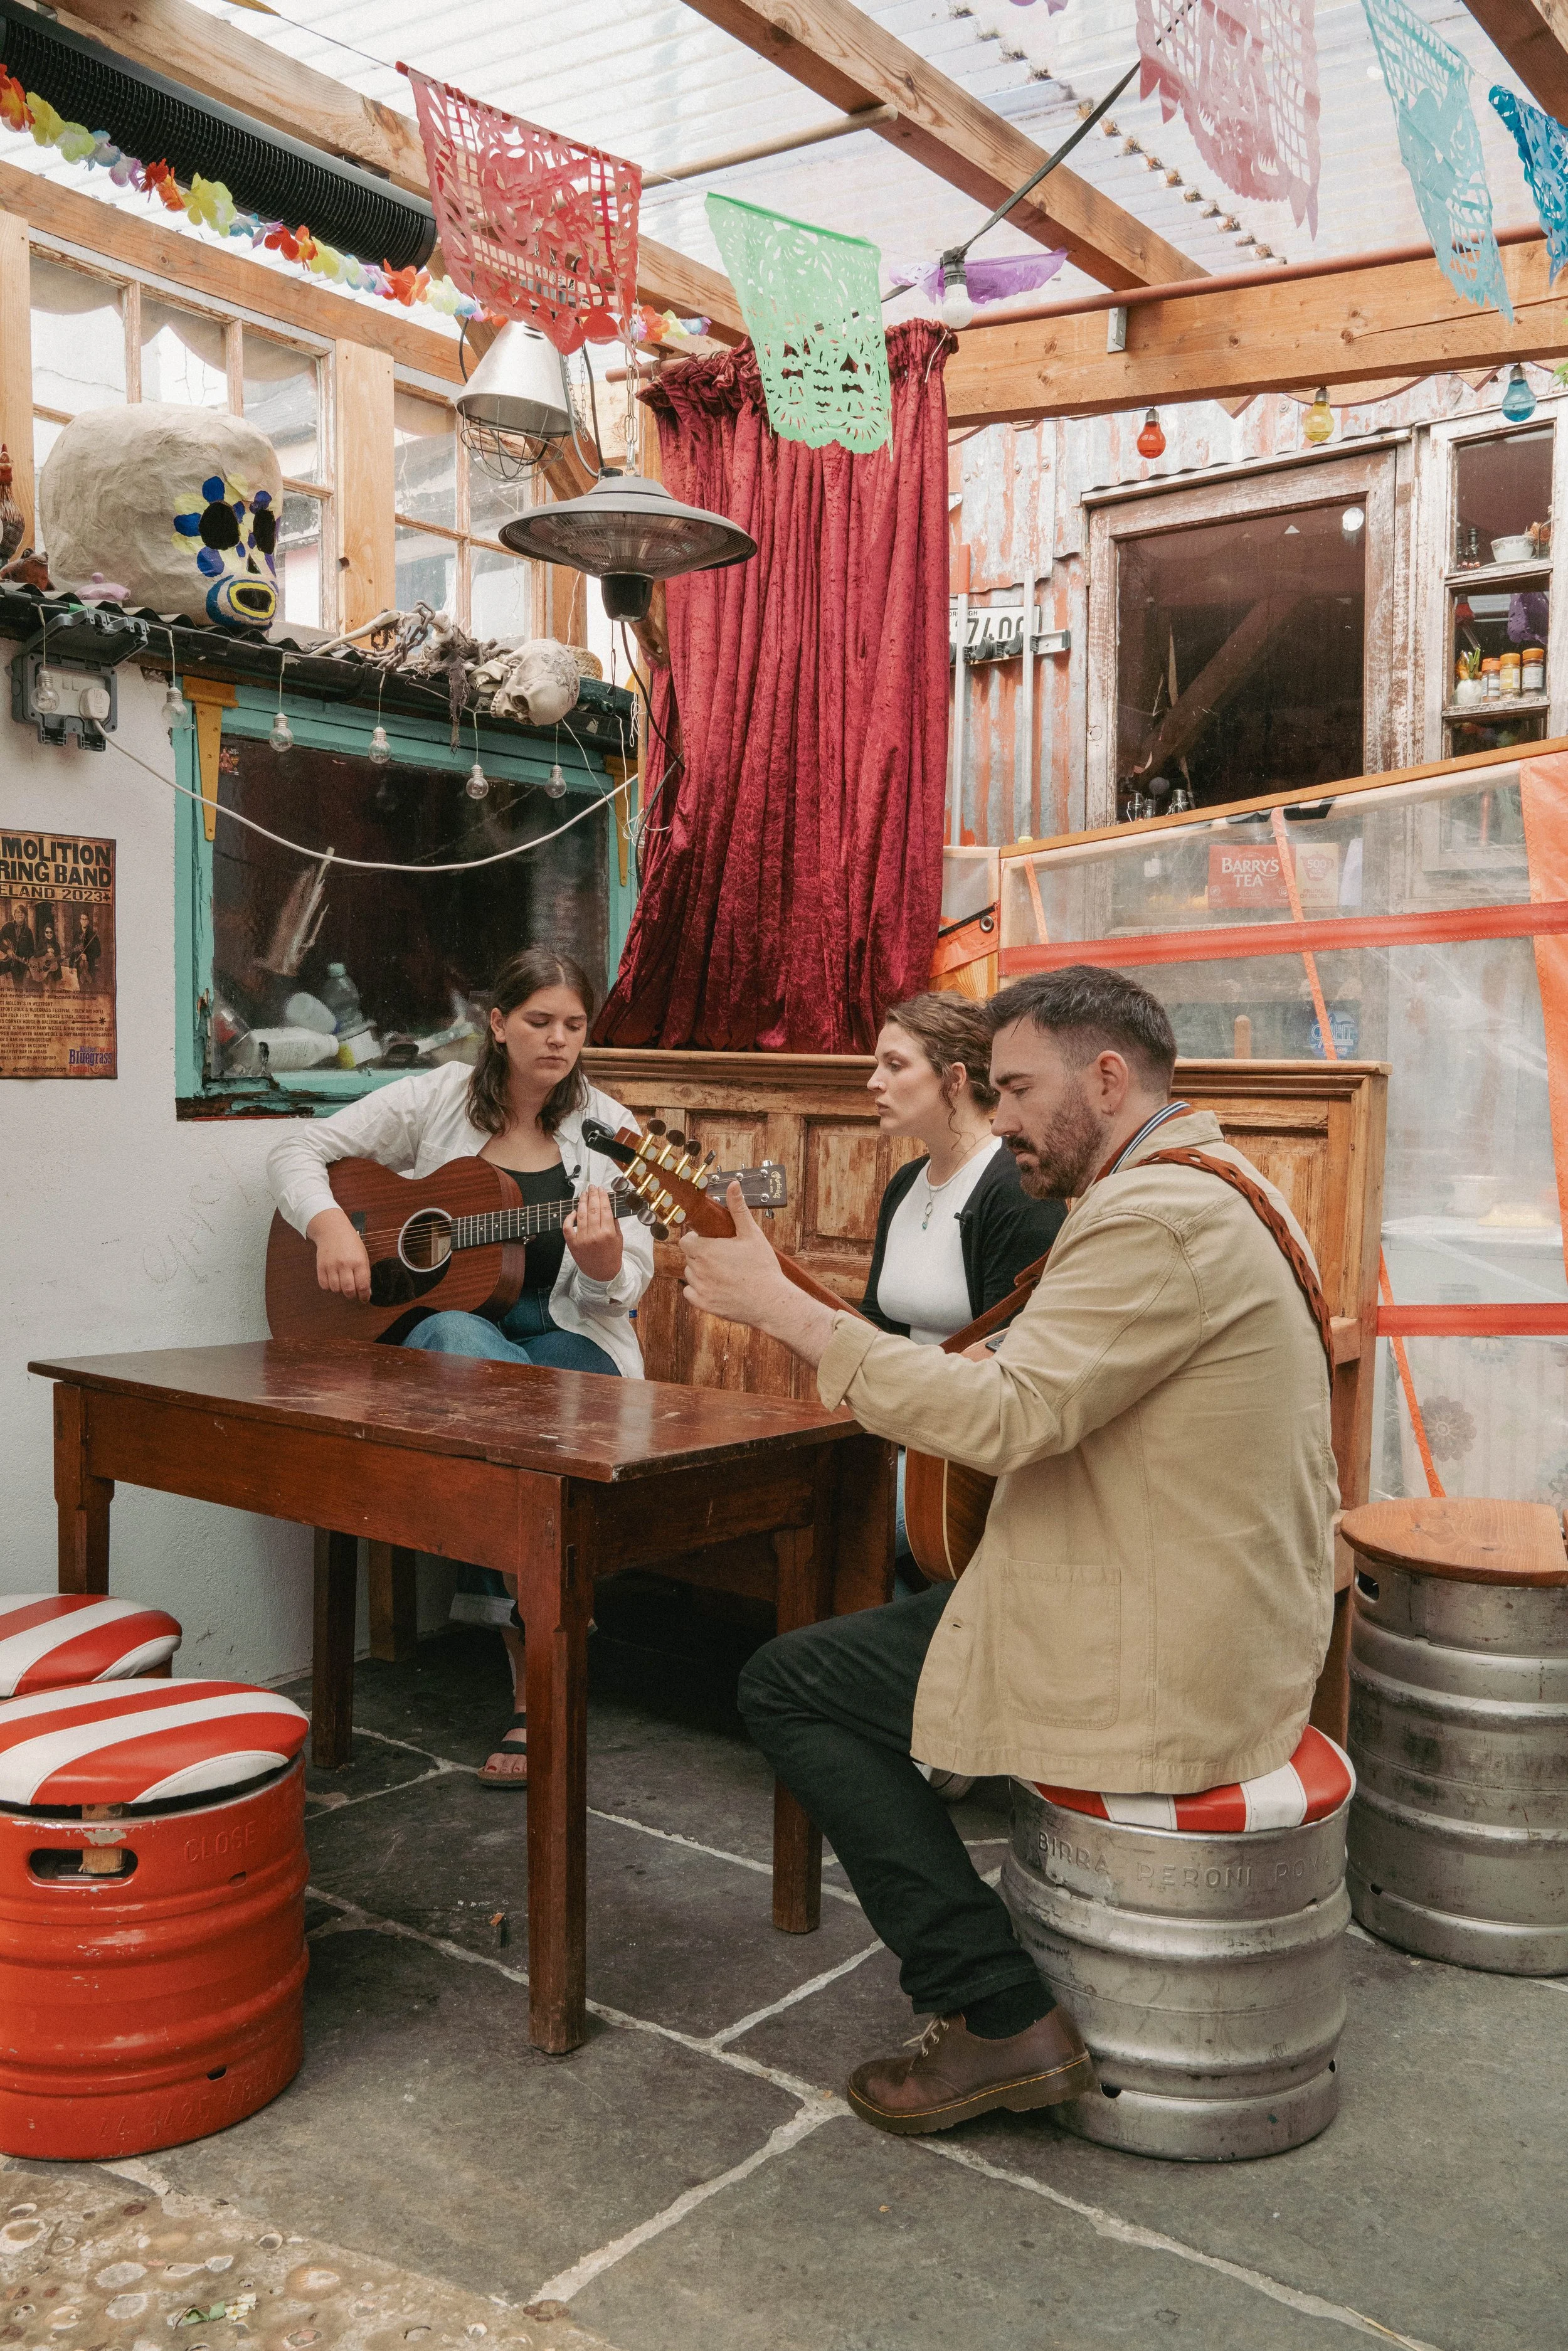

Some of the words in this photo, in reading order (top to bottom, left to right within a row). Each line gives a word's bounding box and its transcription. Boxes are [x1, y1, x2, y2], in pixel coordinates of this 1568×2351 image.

[0, 836, 110, 867] MOLITION
[0, 860, 50, 883] RING
[54, 864, 112, 888] BAND
[1308, 859, 1327, 869] 500
[1233, 874, 1264, 888] TEA
[62, 889, 103, 902] 2023
[68, 1048, 112, 1066] Bluegrass
[184, 1820, 257, 1862] CLOSE
[1039, 1831, 1111, 1876] BIRRA
[1137, 1861, 1252, 1889] PERONI
